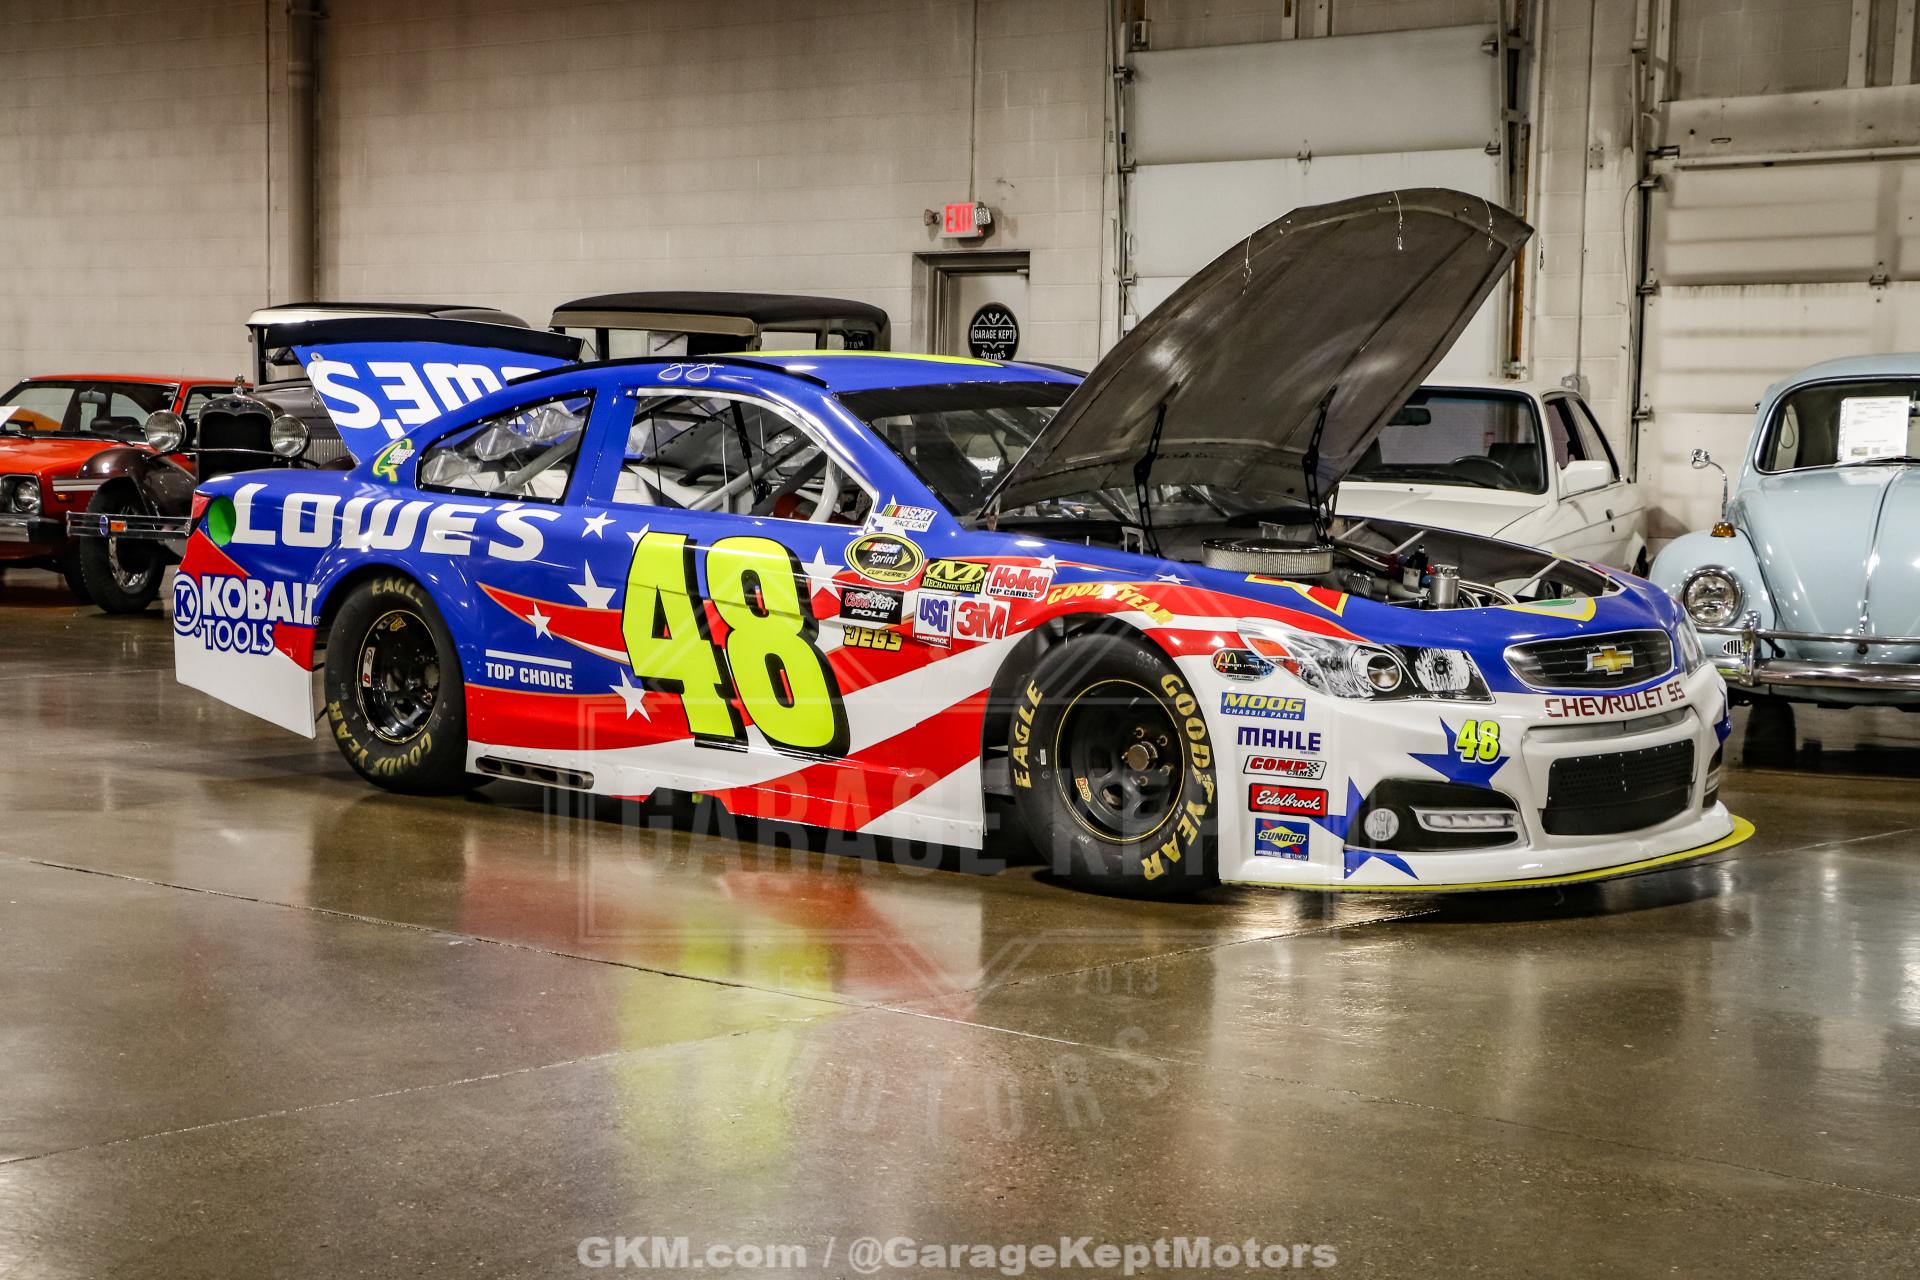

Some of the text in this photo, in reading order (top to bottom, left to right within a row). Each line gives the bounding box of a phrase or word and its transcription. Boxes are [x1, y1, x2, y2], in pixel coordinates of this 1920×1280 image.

[945, 204, 974, 233] EXIT
[974, 330, 1013, 339] GARAGE KEPT
[981, 350, 1006, 360] MOTORS
[232, 483, 562, 562] LOWE'S
[897, 506, 932, 521] NASCAR
[894, 519, 928, 529] RACE CAR
[869, 553, 898, 565] Sprint
[922, 577, 981, 593] MECHANIX WEAR
[992, 567, 1050, 599] Holley
[202, 576, 318, 625] KOBALT
[1003, 589, 1034, 598] CARBS
[870, 597, 898, 611] LIGHT
[851, 609, 890, 619] POLE
[920, 598, 949, 633] USG
[956, 600, 1006, 640] 3M
[203, 619, 274, 654] TOOLS
[621, 531, 848, 760] 48
[485, 662, 574, 691] TOP CHOICE
[1224, 693, 1304, 712] MOOG
[1545, 681, 1686, 718] CHEVROLET SS
[1225, 707, 1300, 720] CHASSIS PARTS
[1012, 679, 1044, 789] EAGLE
[1237, 727, 1322, 751] MAHLE
[1456, 719, 1500, 763] 48
[1250, 757, 1307, 772] COMP
[1286, 769, 1314, 778] CAMS
[1256, 790, 1321, 810] Edelbrock
[1260, 831, 1305, 844] SUNOCO
